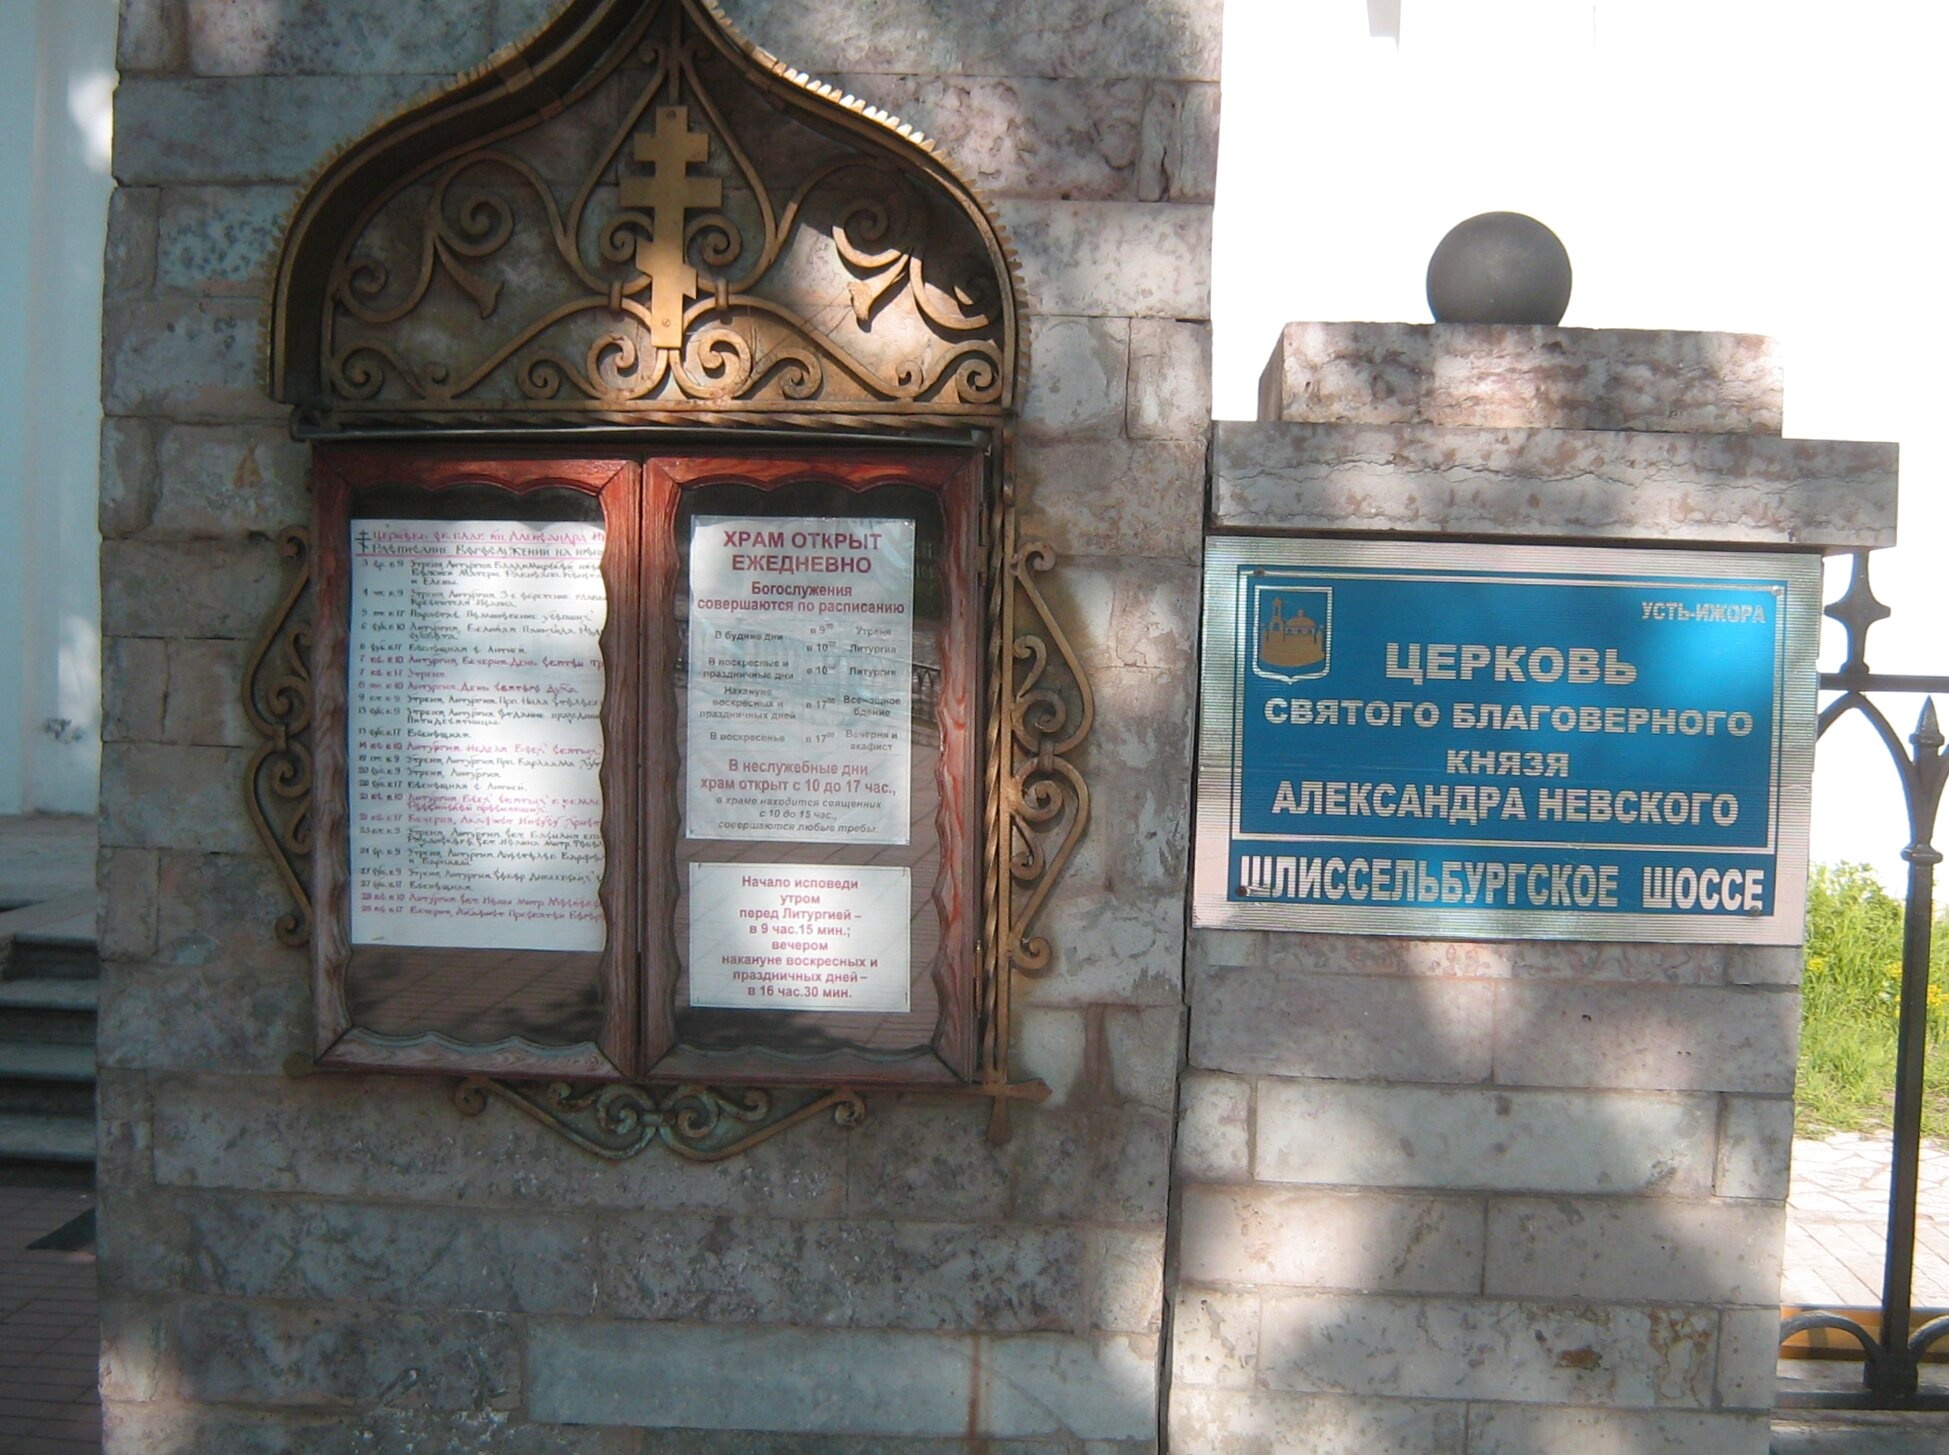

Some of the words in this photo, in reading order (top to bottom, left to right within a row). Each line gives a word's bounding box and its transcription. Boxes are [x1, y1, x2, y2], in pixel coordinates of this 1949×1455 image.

[723, 531, 784, 548] ХРАМ
[792, 533, 882, 550] ОТКРЫТ
[732, 556, 872, 574] ЕЖЕДНЕВНО
[751, 582, 852, 600] Богослужения
[697, 599, 793, 612] совершаются
[798, 601, 815, 611] по
[819, 601, 905, 614] расписанию
[1641, 602, 1765, 624] УСТЬ-ИЖОРА
[715, 631, 721, 639] В
[764, 633, 783, 641] дни
[856, 627, 891, 636] Утреня
[850, 644, 896, 655] Литургия
[709, 657, 715, 665] В
[1386, 642, 1638, 686] ЦЕРКОВЬ
[704, 671, 771, 680] праздничные
[850, 667, 896, 677] Литургия
[724, 687, 772, 696] Накануне
[713, 699, 773, 708] воскресных
[843, 695, 901, 705] Всенощное
[771, 712, 796, 720] дней
[854, 708, 891, 716] бдение
[1264, 698, 1440, 726] СВЯТОГО
[1452, 702, 1754, 736] БЛАГОВЕРНОГО
[710, 732, 717, 740] В
[720, 734, 785, 742] воскресенье
[846, 729, 889, 739] Вечерня
[850, 743, 892, 752] акафист
[729, 759, 738, 771] В
[743, 761, 838, 777] неслужебные
[842, 763, 867, 776] дни
[1446, 750, 1569, 778] КНЯЗЯ
[701, 779, 734, 791] храм
[739, 780, 788, 793] открыт
[806, 779, 819, 792] 10
[824, 783, 841, 794] до
[847, 780, 861, 792] 17
[726, 798, 757, 807] храме
[760, 798, 819, 807] находится
[822, 800, 881, 808] священник
[1272, 781, 1526, 825] АЛЕКСАНДРА
[1538, 791, 1738, 826] НЕВСКОГО
[783, 810, 795, 818] до
[718, 821, 795, 831] совершаются
[797, 822, 834, 832] любые
[742, 876, 791, 888] Начало
[795, 878, 858, 891] исповеди
[1239, 855, 1618, 908] ШЛИССЕЛЬБУРГСКОЕ
[1642, 866, 1764, 911] ШОССЕ
[781, 894, 820, 907] утром
[740, 909, 779, 921] перед
[783, 908, 851, 921] Литургией
[750, 925, 757, 933] в
[761, 924, 769, 934] 9
[817, 926, 851, 938] мин.;
[772, 940, 828, 953] вечером
[722, 955, 782, 969] накануне
[786, 956, 866, 969] воскресных
[870, 958, 878, 967] и
[733, 970, 821, 984] праздничных
[826, 971, 858, 984] дней
[748, 987, 755, 995] в
[760, 986, 774, 996] 16
[822, 988, 852, 998] мин.
